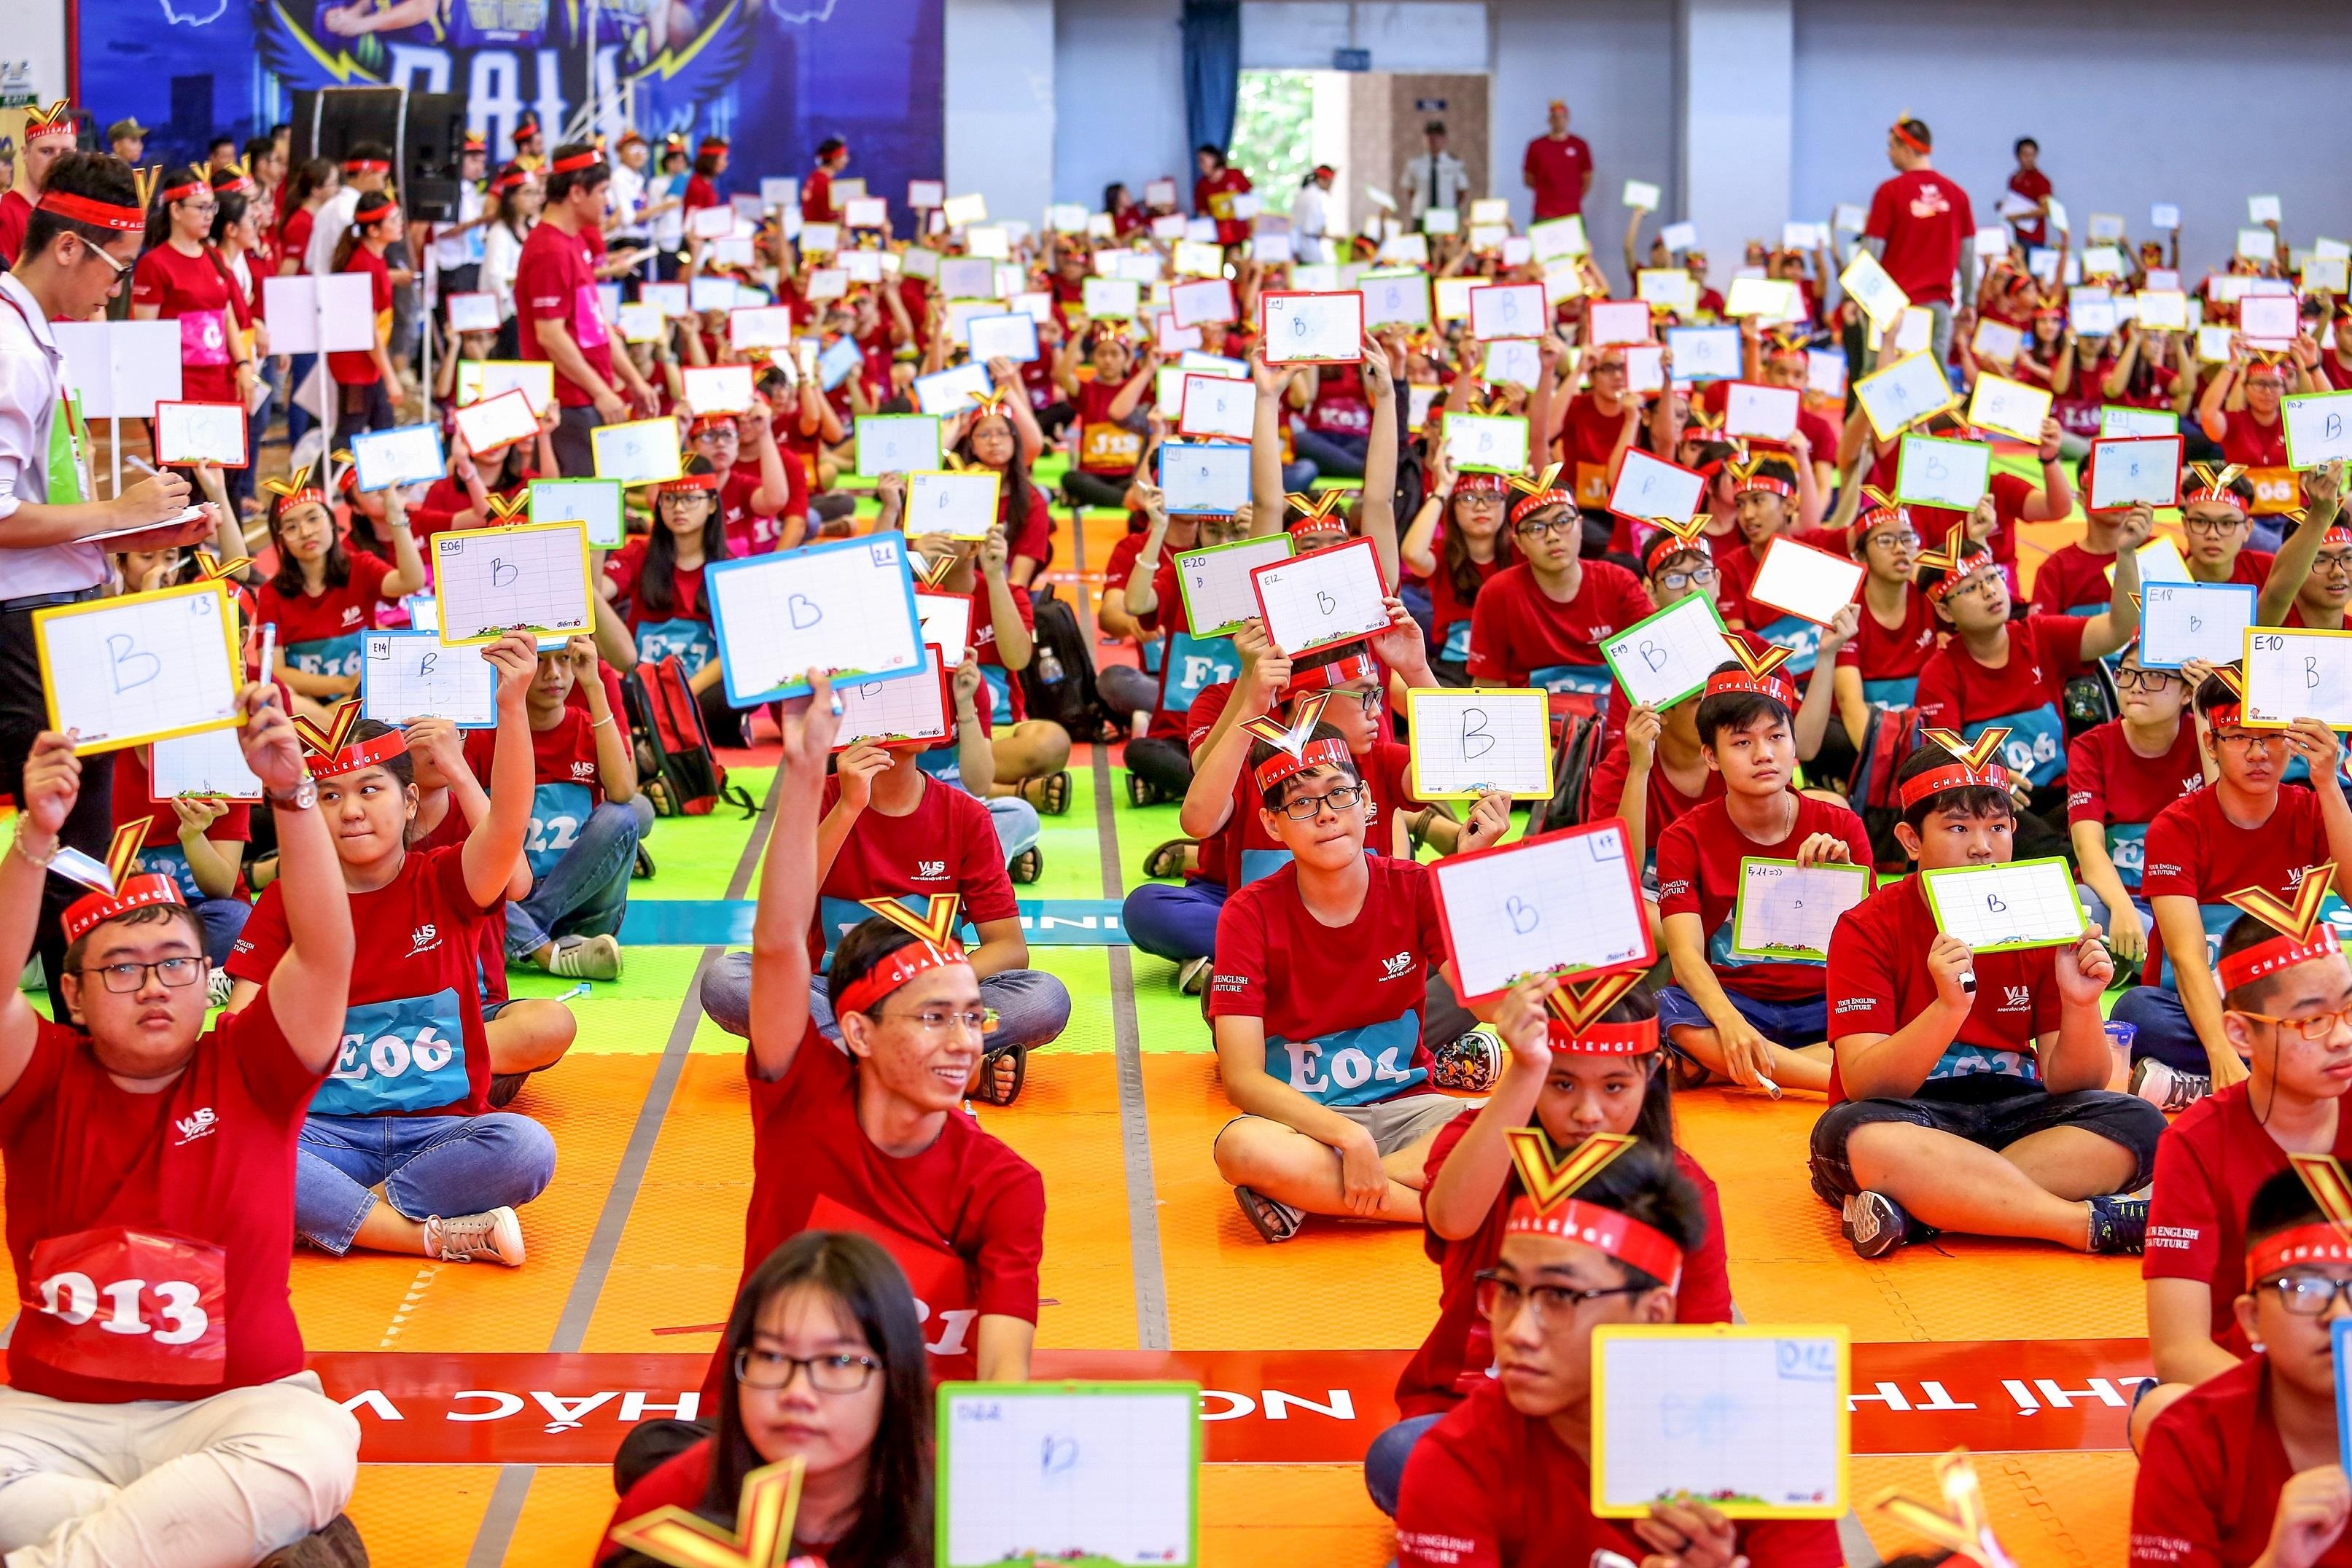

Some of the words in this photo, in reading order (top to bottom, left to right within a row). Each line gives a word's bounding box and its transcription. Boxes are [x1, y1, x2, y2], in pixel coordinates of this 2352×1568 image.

[1294, 318, 1306, 336] B
[2326, 413, 2342, 440] B
[2131, 463, 2139, 477] B
[441, 541, 461, 552] E06
[1183, 557, 1207, 569] E20
[490, 558, 518, 588] B
[1264, 573, 1283, 586] E12
[1197, 577, 1204, 589] B
[1317, 590, 1336, 616] B
[2149, 589, 2173, 602] E18
[190, 596, 212, 616] 13
[790, 594, 822, 630] B
[2191, 615, 2203, 633] B
[373, 642, 386, 655] E14
[1611, 643, 1628, 658] E19
[2254, 636, 2283, 651] E10
[107, 633, 161, 695] B
[420, 652, 437, 678] B
[1640, 640, 1667, 674] B
[1178, 658, 1234, 688] F1
[2305, 656, 2321, 689] B
[2220, 714, 2240, 725] CHA
[1461, 709, 1495, 763] B
[2007, 732, 2056, 770] 06
[571, 761, 596, 779] VUS
[1266, 750, 1346, 784] CHALLENGE
[523, 815, 580, 852] 22
[919, 862, 946, 875] VUS
[1794, 901, 1803, 909] B
[1987, 894, 2006, 913] B
[1506, 895, 1540, 935] B
[237, 939, 255, 950] NGLISH
[411, 924, 437, 949] VUS
[233, 944, 248, 954] TURE
[1382, 951, 1411, 973] VUS
[1218, 975, 1248, 985] ENGLISH
[1835, 1006, 1848, 1014] YOUR
[1848, 1004, 1872, 1012] FUTURE
[332, 1026, 453, 1081] E06
[1548, 1040, 1635, 1053] ALLENGE
[175, 1107, 217, 1139] VUS
[2158, 1226, 2199, 1240] ENGLISH
